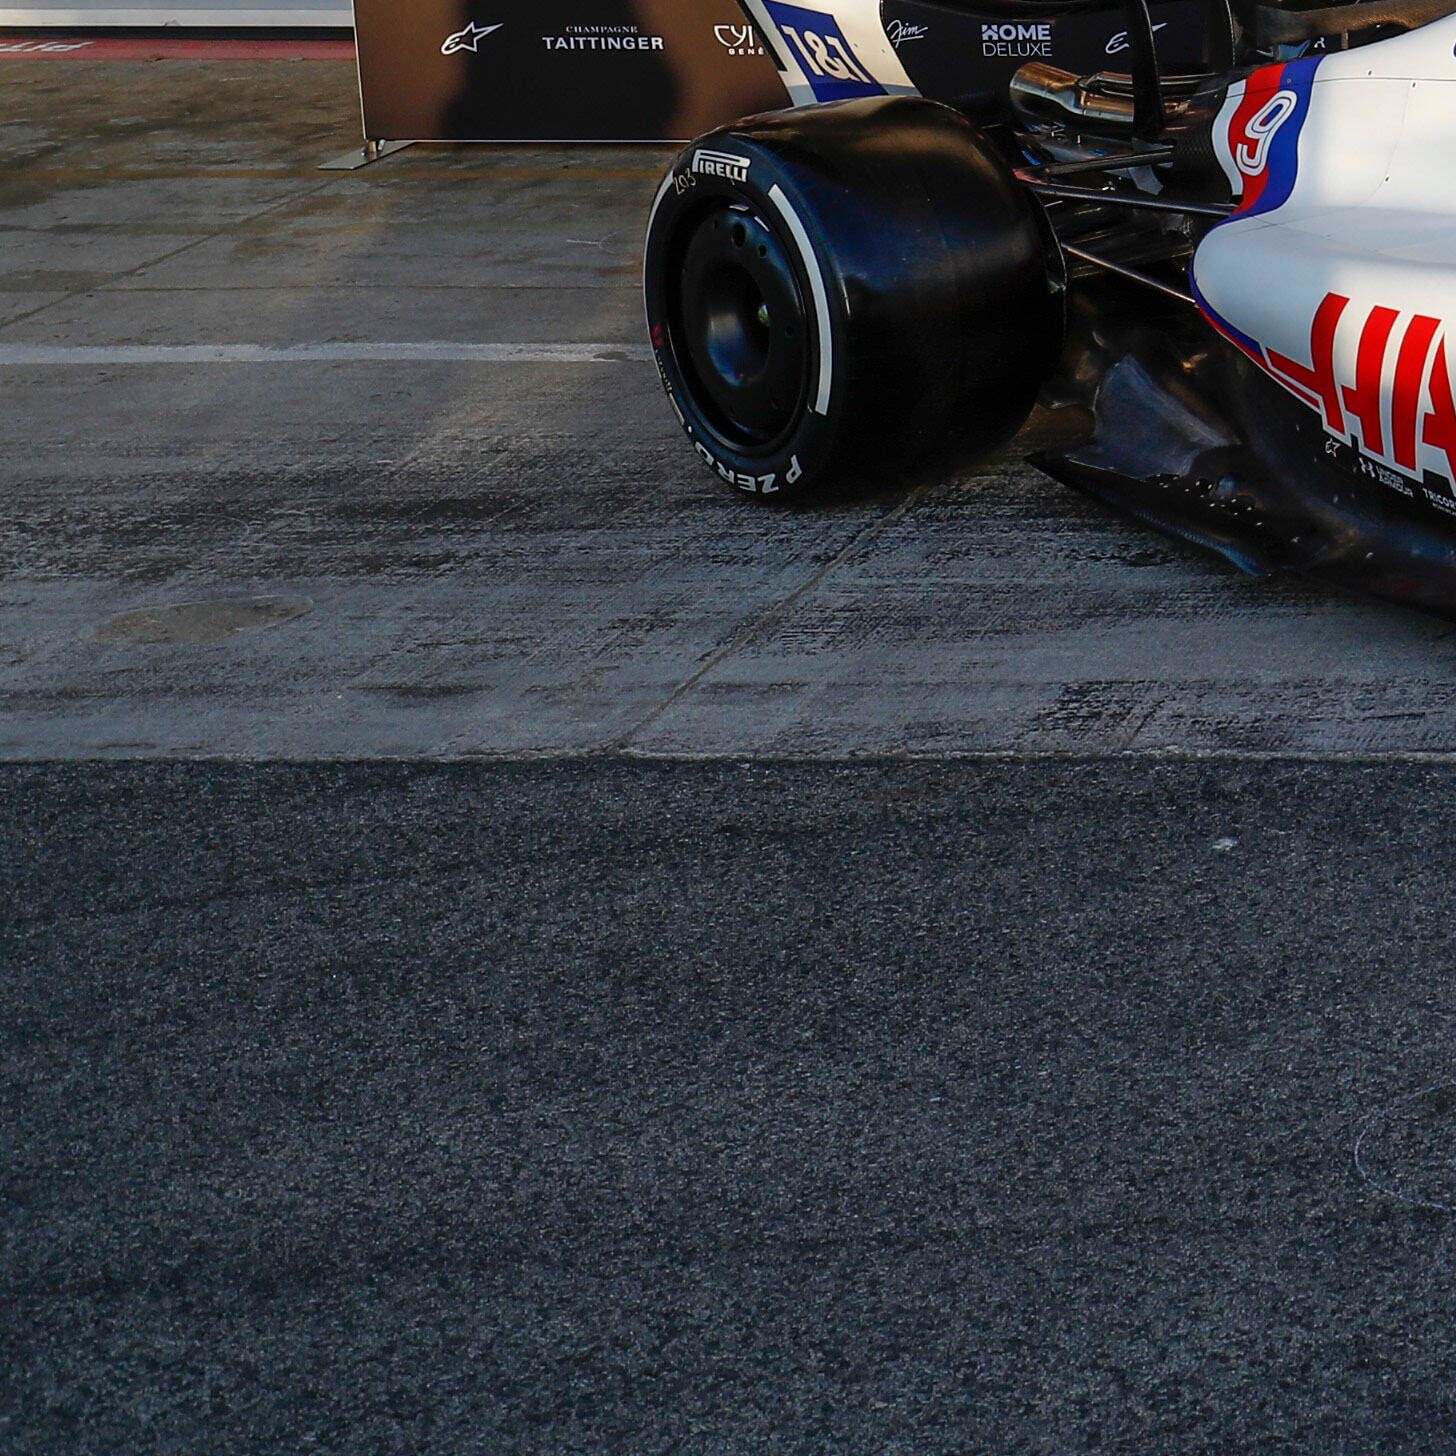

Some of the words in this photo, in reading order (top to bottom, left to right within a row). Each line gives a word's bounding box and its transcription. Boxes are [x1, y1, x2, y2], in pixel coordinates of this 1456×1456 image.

[542, 37, 664, 50] TAITTINGER
[981, 24, 1051, 40] HOME
[781, 24, 871, 85] 1&1
[983, 41, 1052, 57] DELUXE
[1235, 90, 1297, 177] 9
[692, 149, 752, 182] PIRELLI
